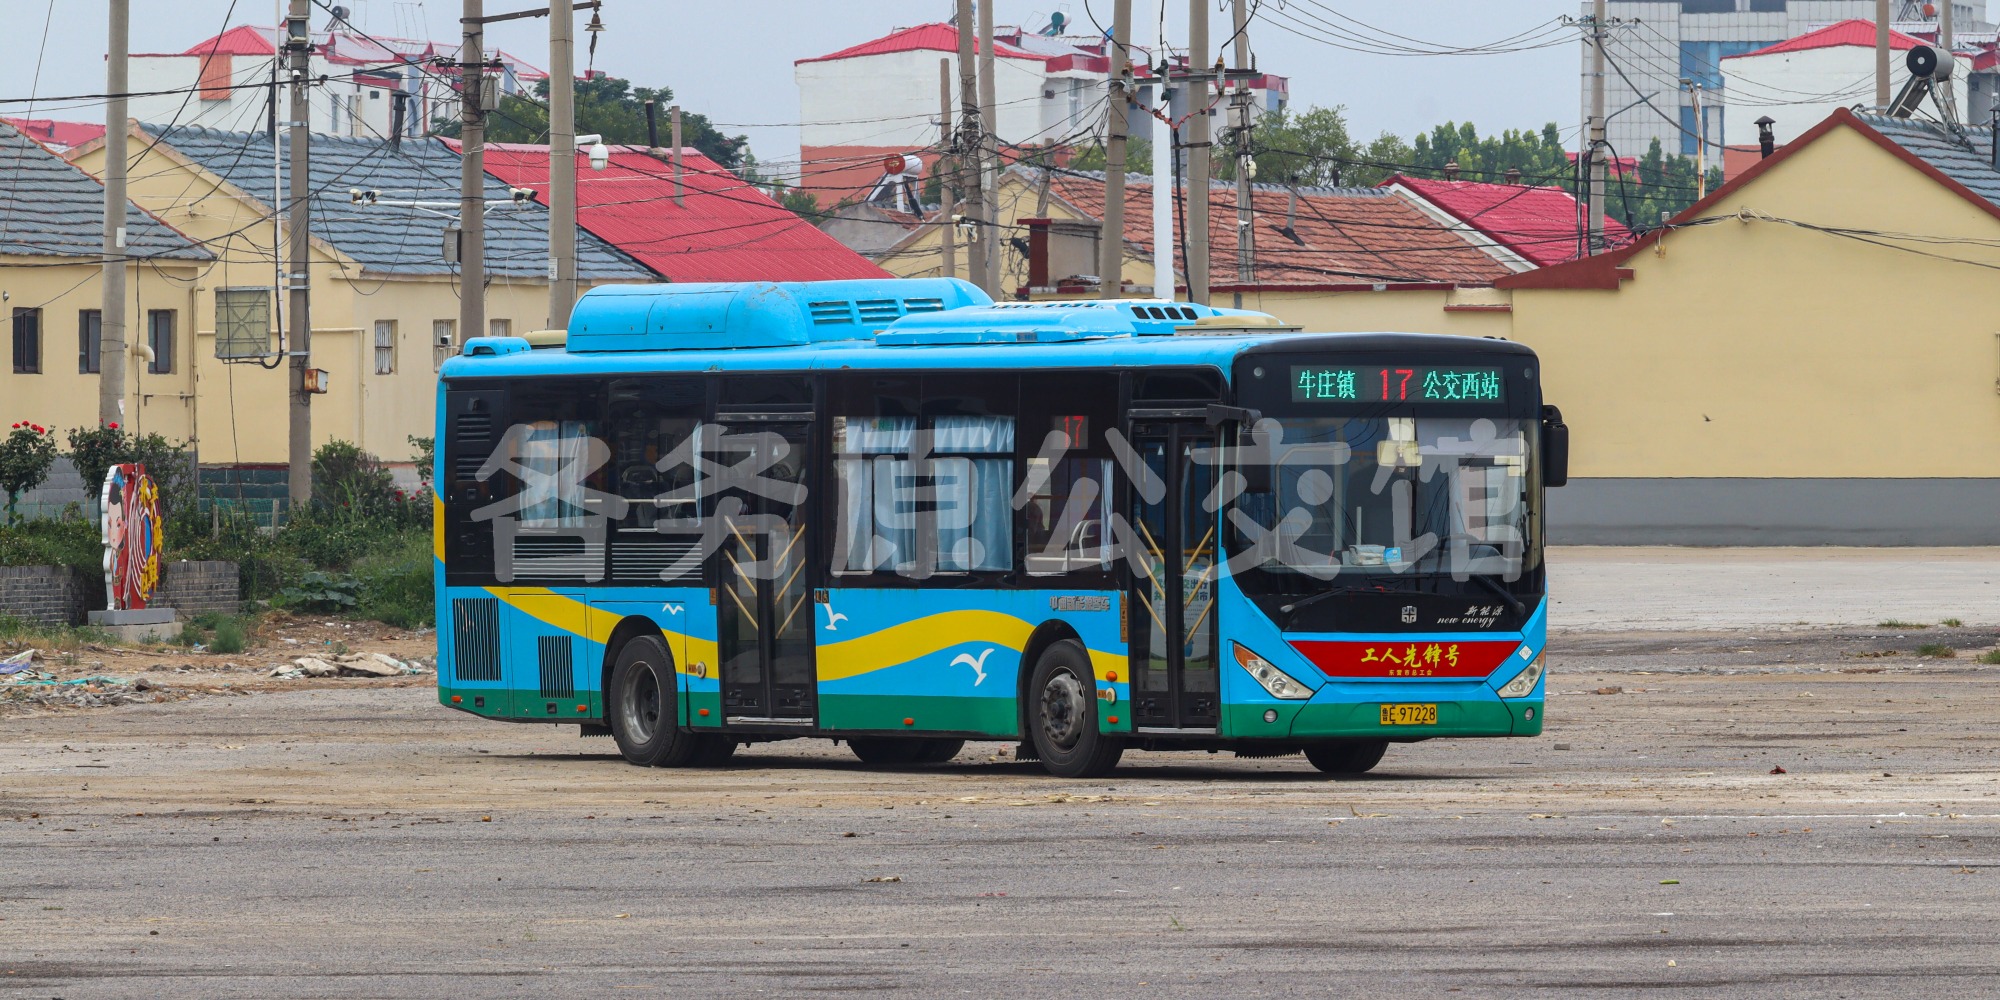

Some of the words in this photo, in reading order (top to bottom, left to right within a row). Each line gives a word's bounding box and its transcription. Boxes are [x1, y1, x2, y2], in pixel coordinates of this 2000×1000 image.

[1297, 369, 1356, 399] 牛庄镇
[1380, 369, 1413, 400] 17
[1422, 370, 1500, 399] 公交西站
[1064, 415, 1084, 448] 17
[1462, 617, 1496, 628] energy
[1464, 605, 1504, 616] 新能源
[1360, 643, 1460, 668] 工人先锋号
